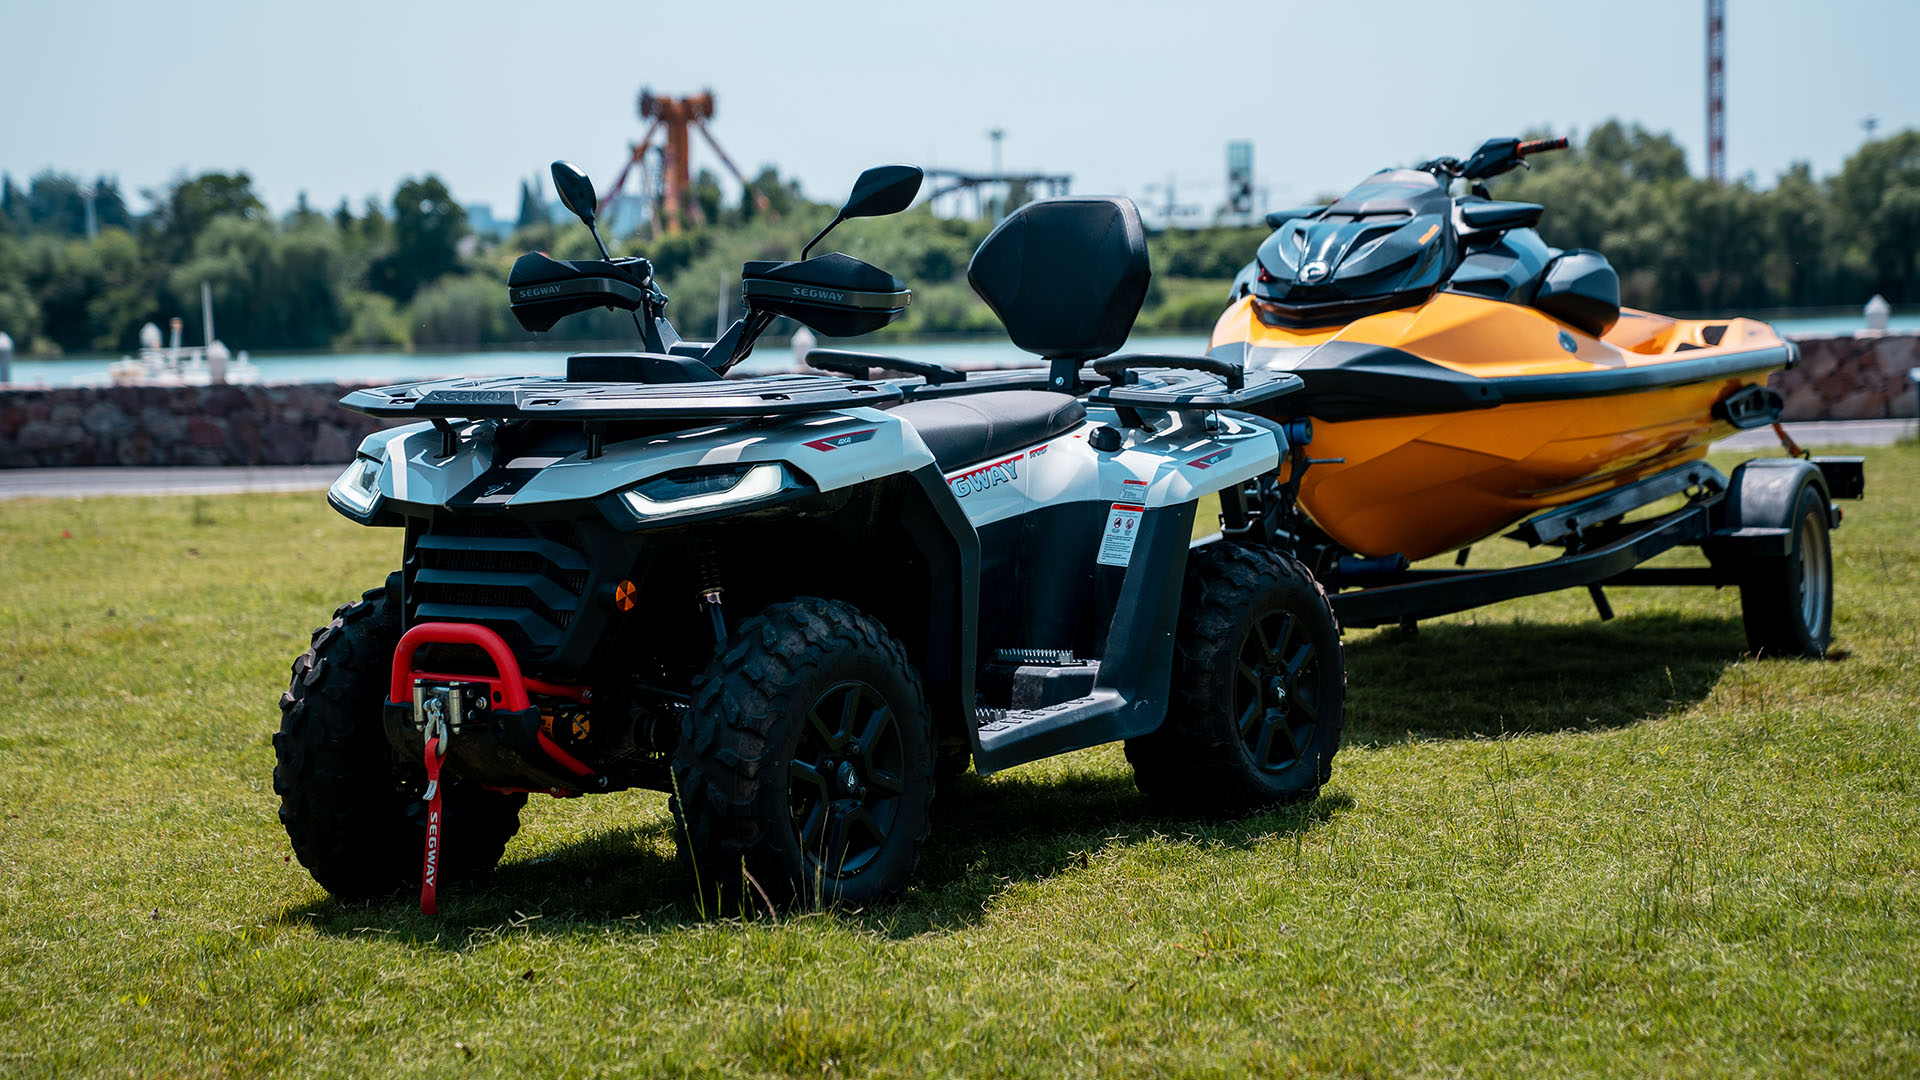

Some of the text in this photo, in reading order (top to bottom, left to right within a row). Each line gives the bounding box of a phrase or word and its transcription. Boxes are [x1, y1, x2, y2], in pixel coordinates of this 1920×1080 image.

[520, 285, 560, 298] SEGWAY
[792, 287, 844, 301] SEGWAY
[430, 391, 509, 402] SEGWAY
[426, 811, 438, 887] SEGWAY
